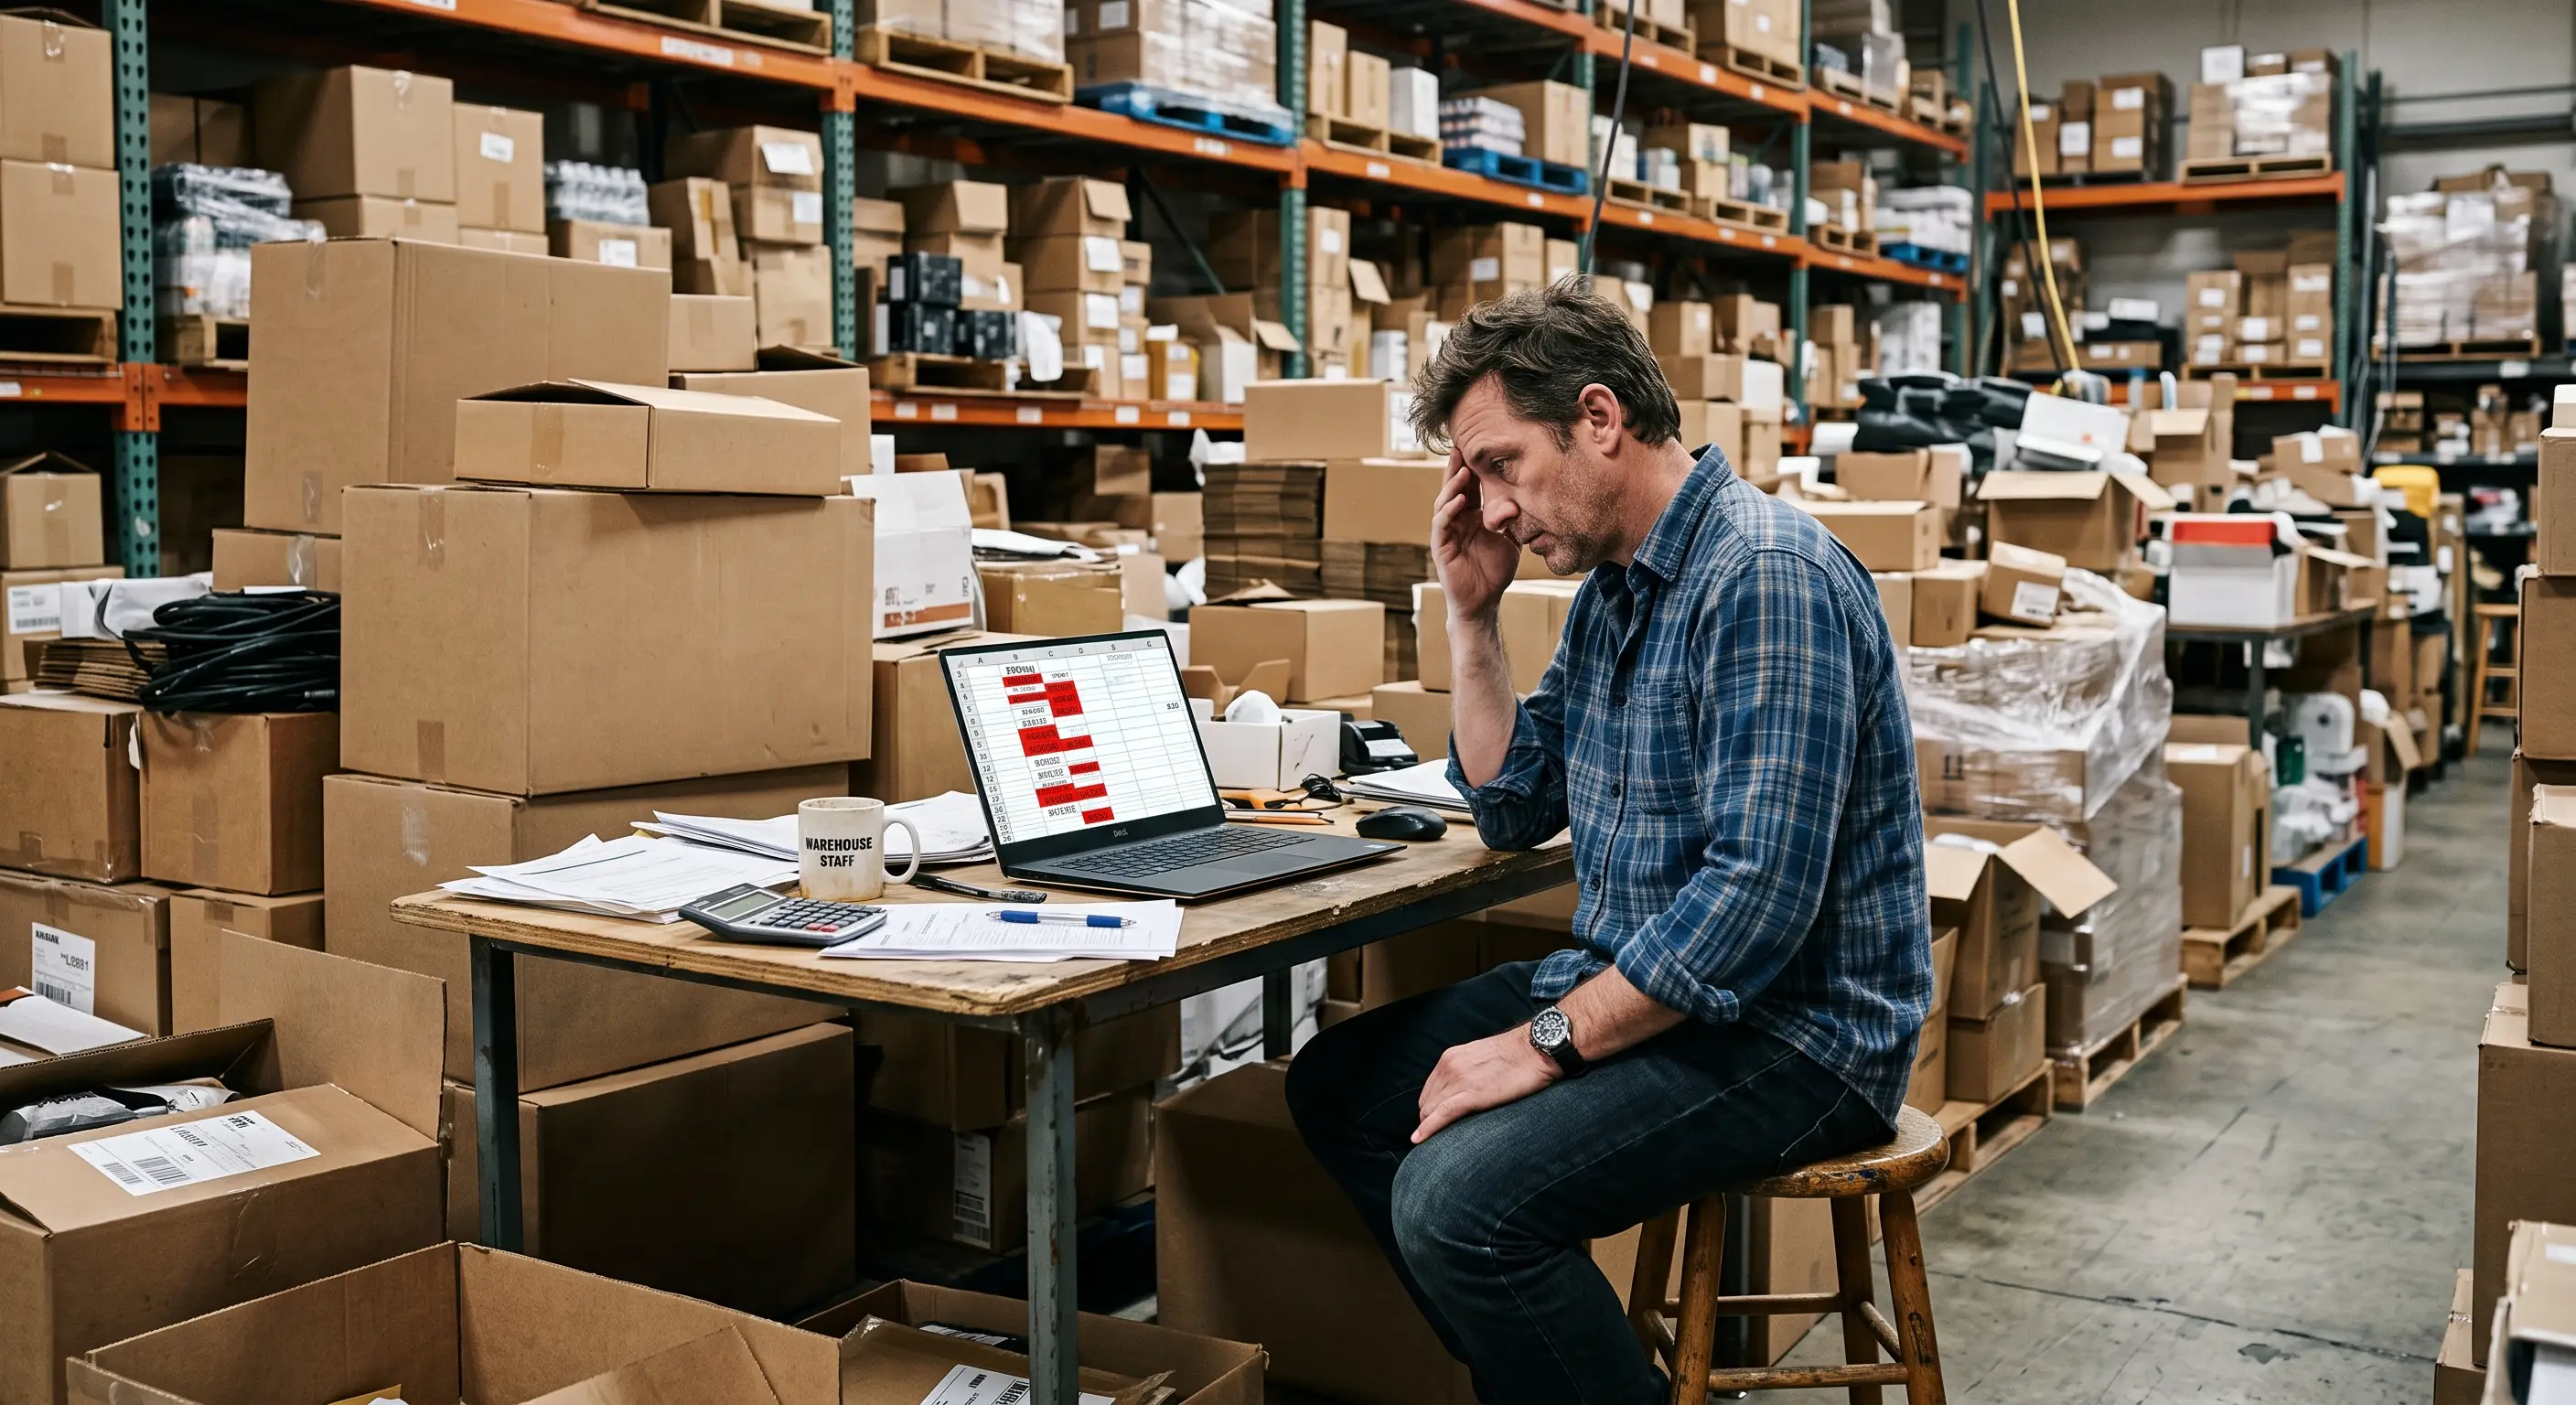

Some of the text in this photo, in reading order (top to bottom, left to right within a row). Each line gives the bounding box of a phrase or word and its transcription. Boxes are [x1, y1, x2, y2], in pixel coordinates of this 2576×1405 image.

[978, 657, 984, 665] A
[996, 815, 1006, 823] 22
[805, 836, 873, 852] WAREHOUSE
[820, 854, 854, 867] STAFF
